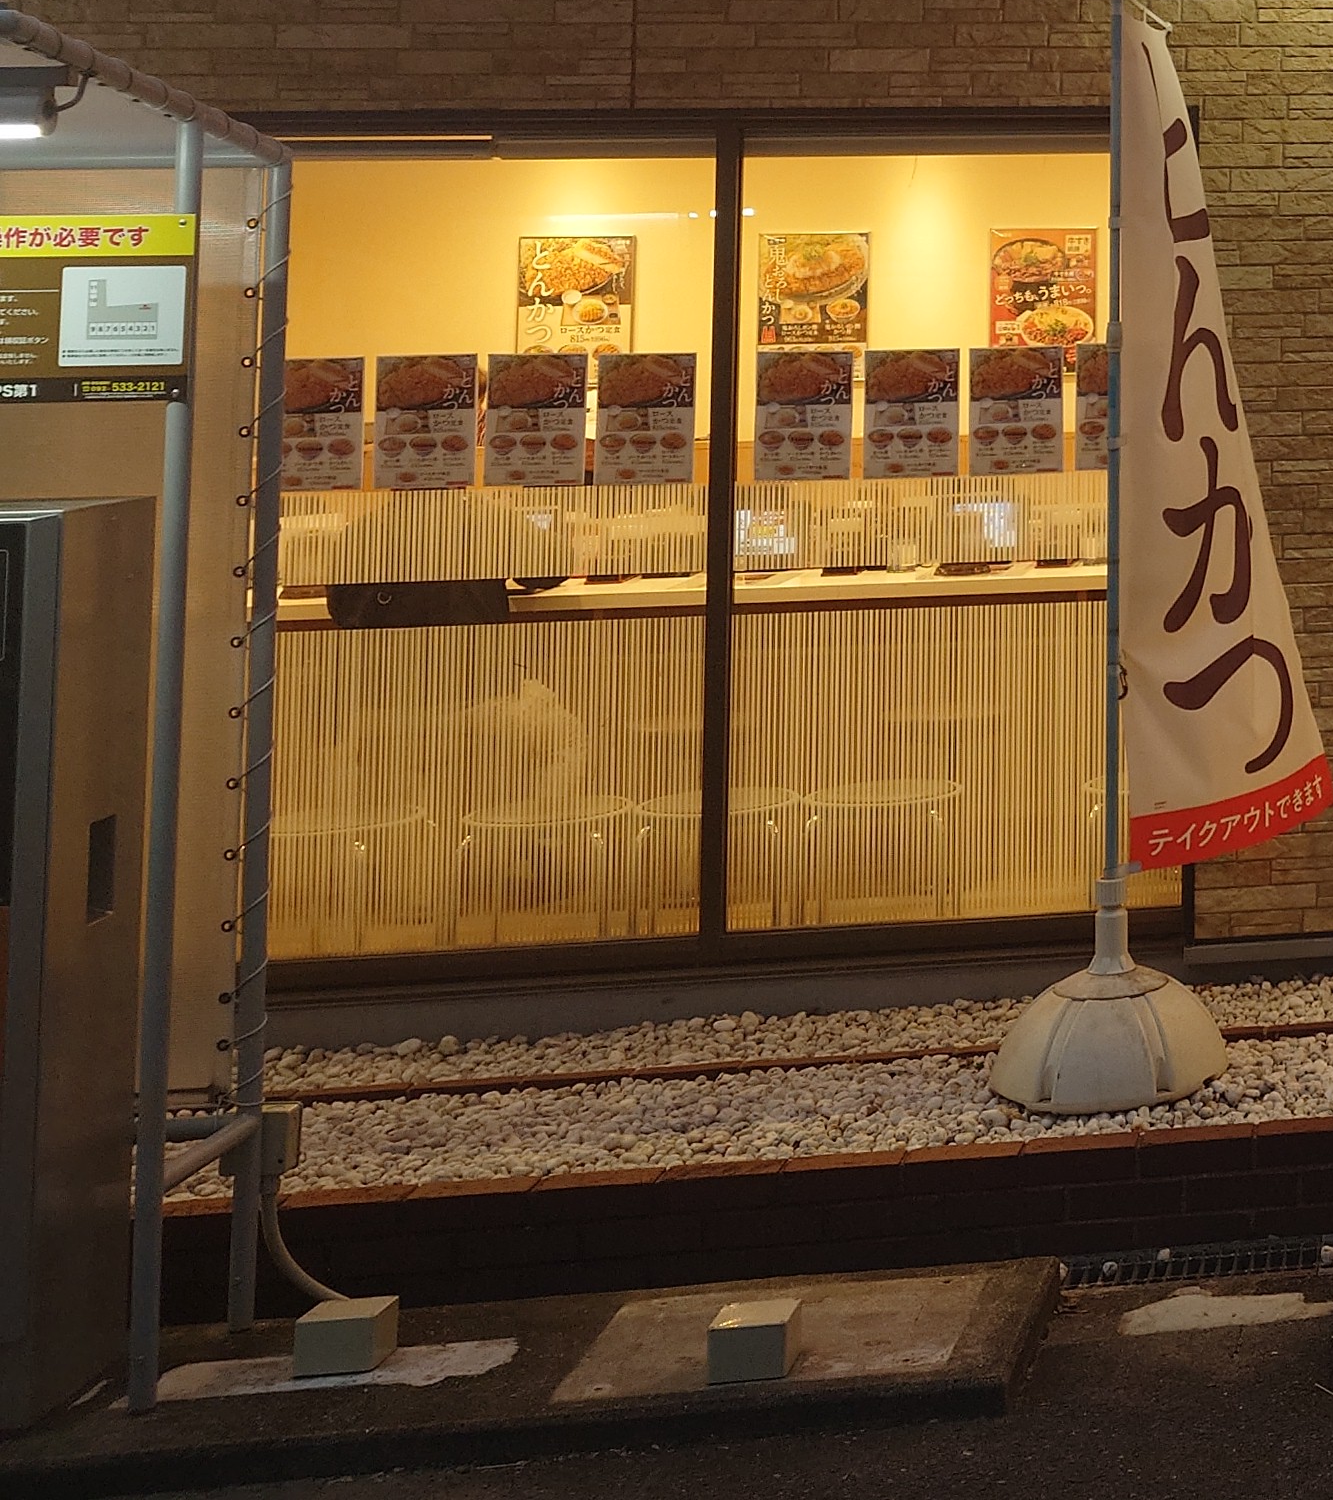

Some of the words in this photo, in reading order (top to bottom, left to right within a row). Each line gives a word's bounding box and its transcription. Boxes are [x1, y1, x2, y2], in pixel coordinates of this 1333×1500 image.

[0, 226, 150, 249] 作が必要です
[525, 240, 555, 343] とんかつ
[1148, 773, 1323, 856] テイクアウトできます
